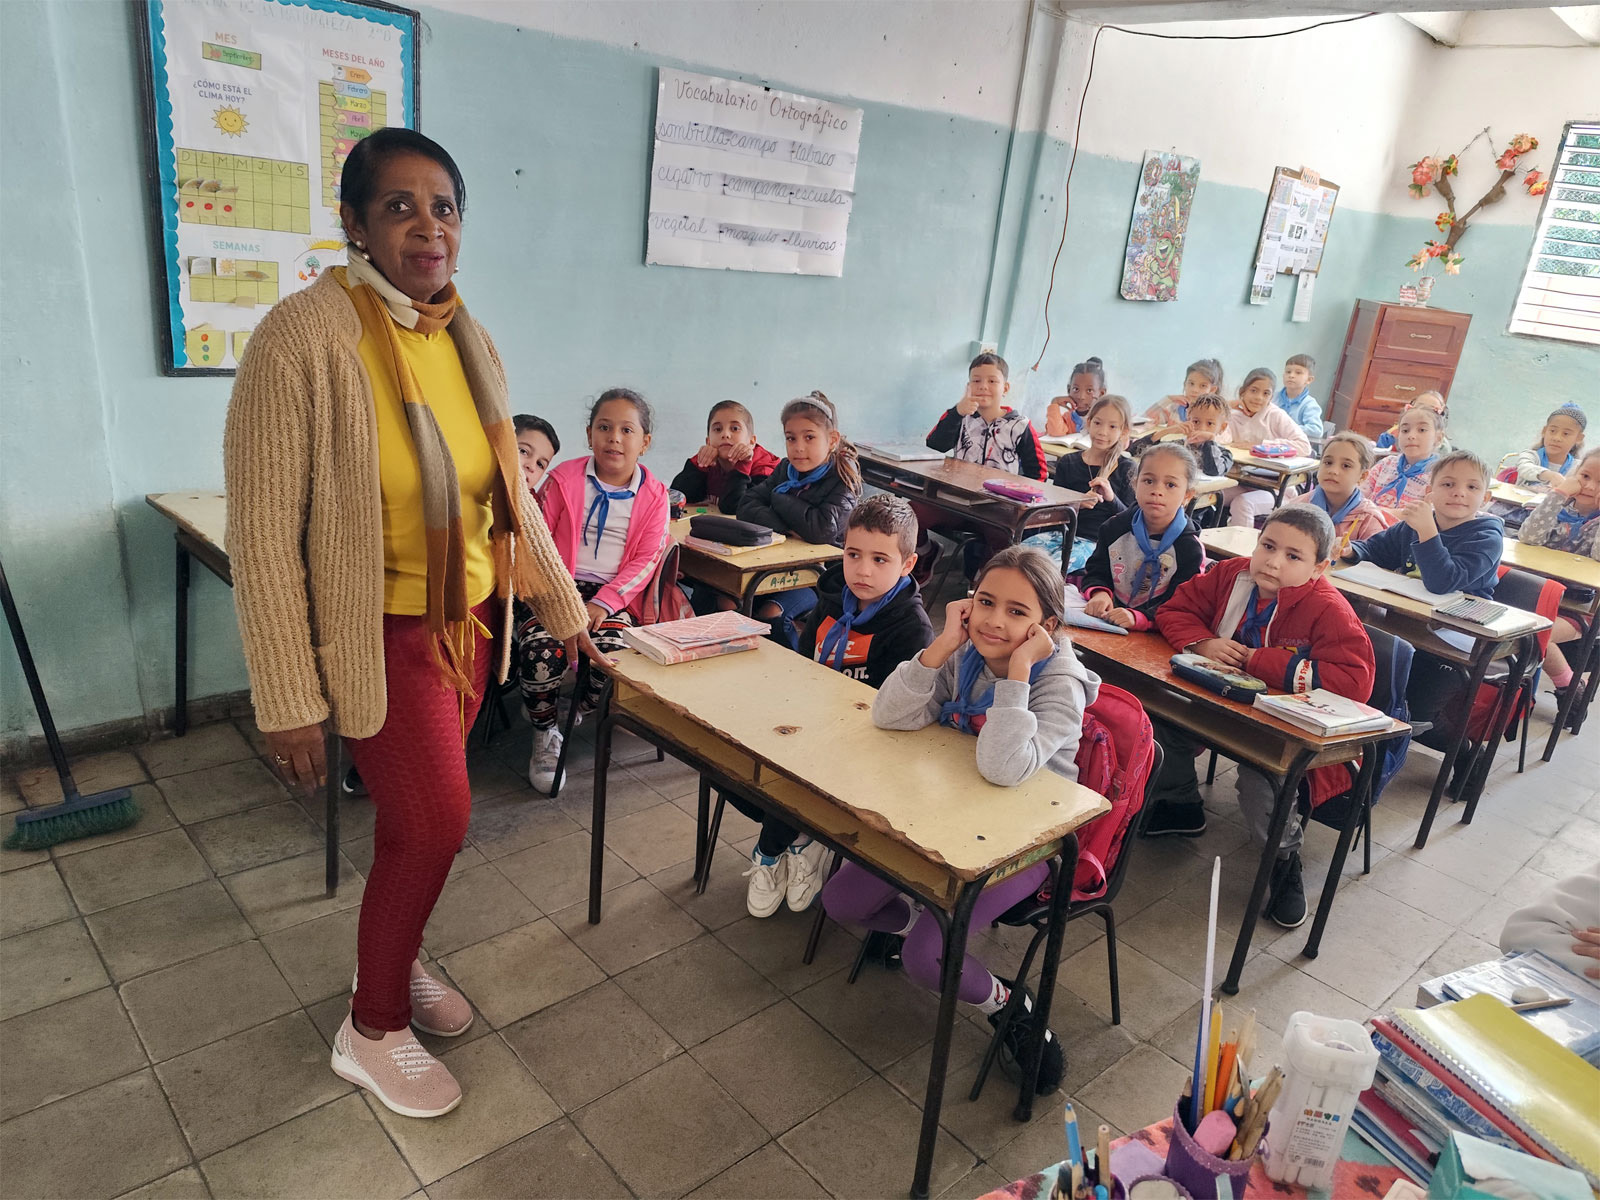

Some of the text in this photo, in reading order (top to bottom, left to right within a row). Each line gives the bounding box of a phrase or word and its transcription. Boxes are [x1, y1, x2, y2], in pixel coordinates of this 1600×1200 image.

[215, 32, 238, 45] MES
[322, 48, 385, 68] MESES DEL AÑO
[193, 79, 221, 91] ¿CÓMO
[243, 87, 252, 96] EL
[198, 90, 245, 104] CLIMA HOY?
[674, 78, 848, 134] Vocabulario Ortográfico
[182, 150, 304, 176] D L M M J V S
[657, 166, 713, 190] cigarro
[212, 240, 261, 253] SEMANAS
